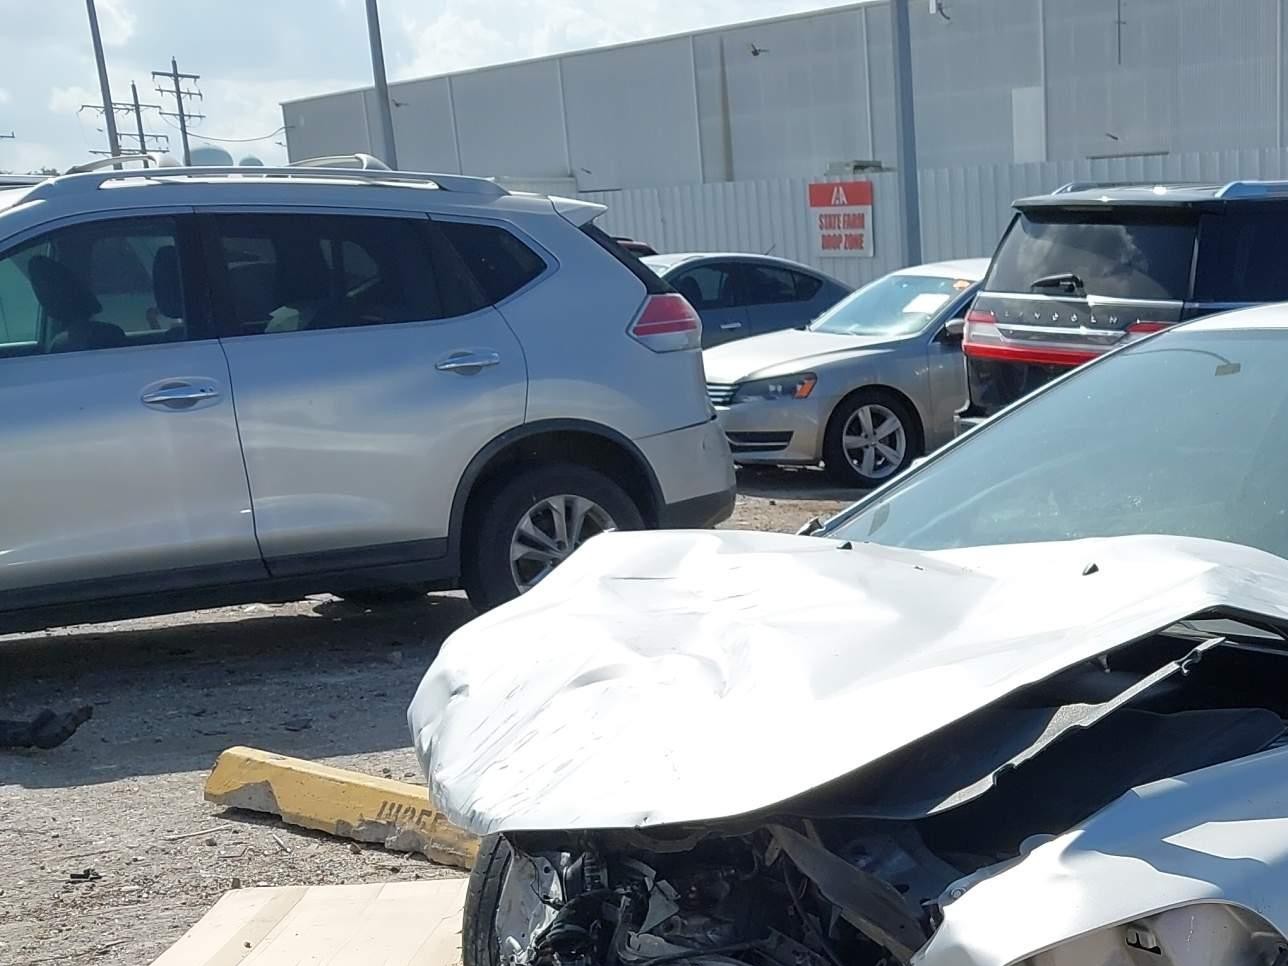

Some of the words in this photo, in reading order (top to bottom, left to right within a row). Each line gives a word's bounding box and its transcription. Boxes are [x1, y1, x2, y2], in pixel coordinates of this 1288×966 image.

[818, 213, 842, 231] STATE
[842, 212, 865, 230] FARM
[821, 233, 842, 250] DROP
[843, 233, 865, 250] ZONE
